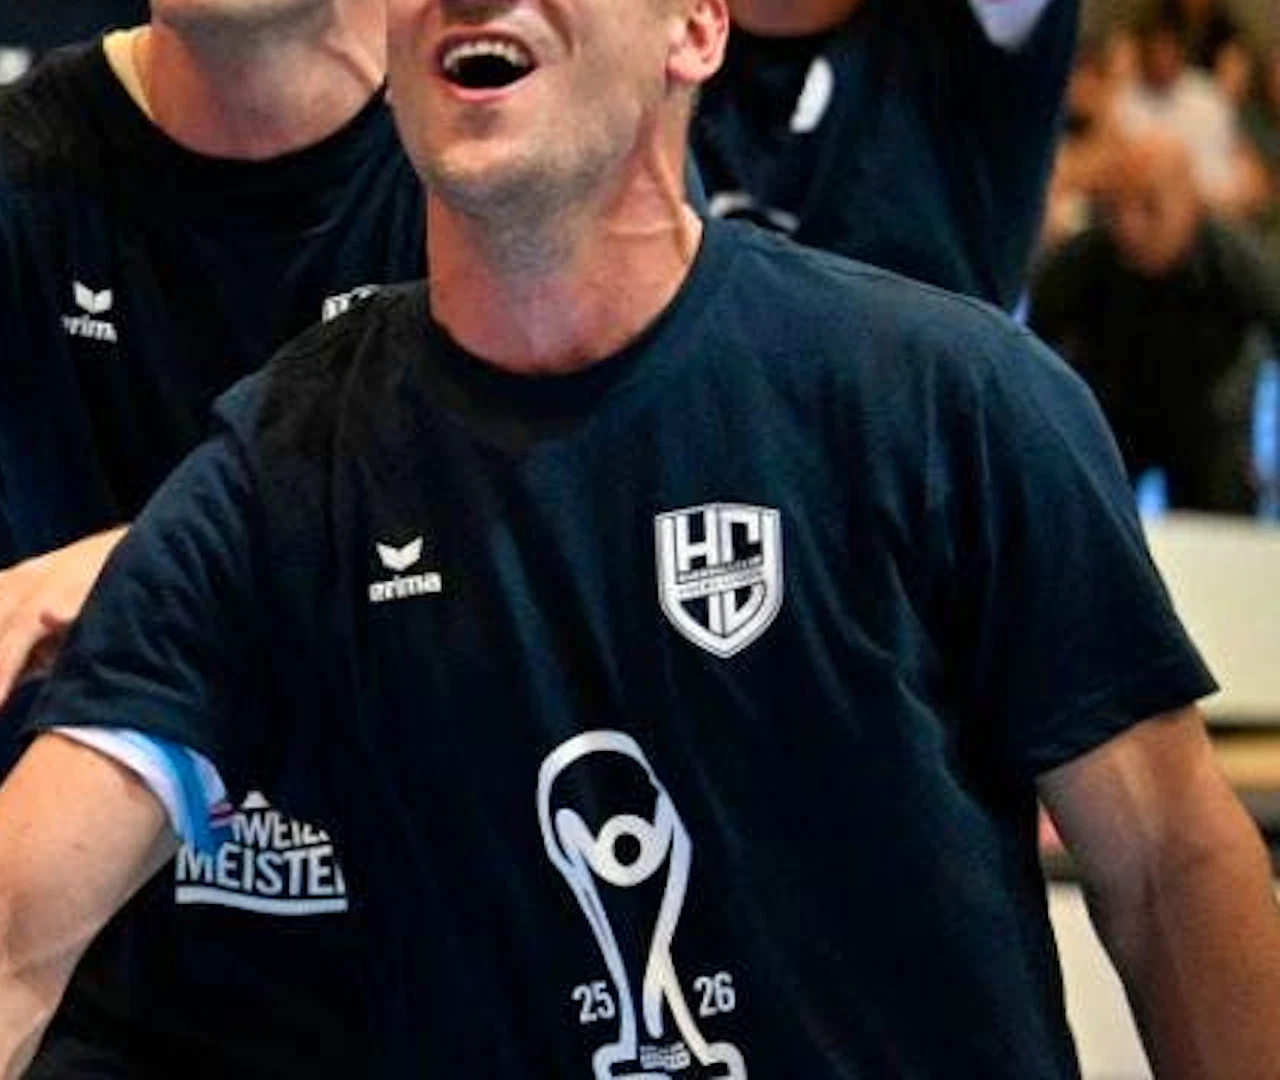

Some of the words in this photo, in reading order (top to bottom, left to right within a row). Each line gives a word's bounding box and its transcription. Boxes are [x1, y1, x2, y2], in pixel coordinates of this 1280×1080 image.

[368, 572, 442, 602] erima
[571, 980, 616, 1024] 25
[693, 971, 736, 1017] 26
